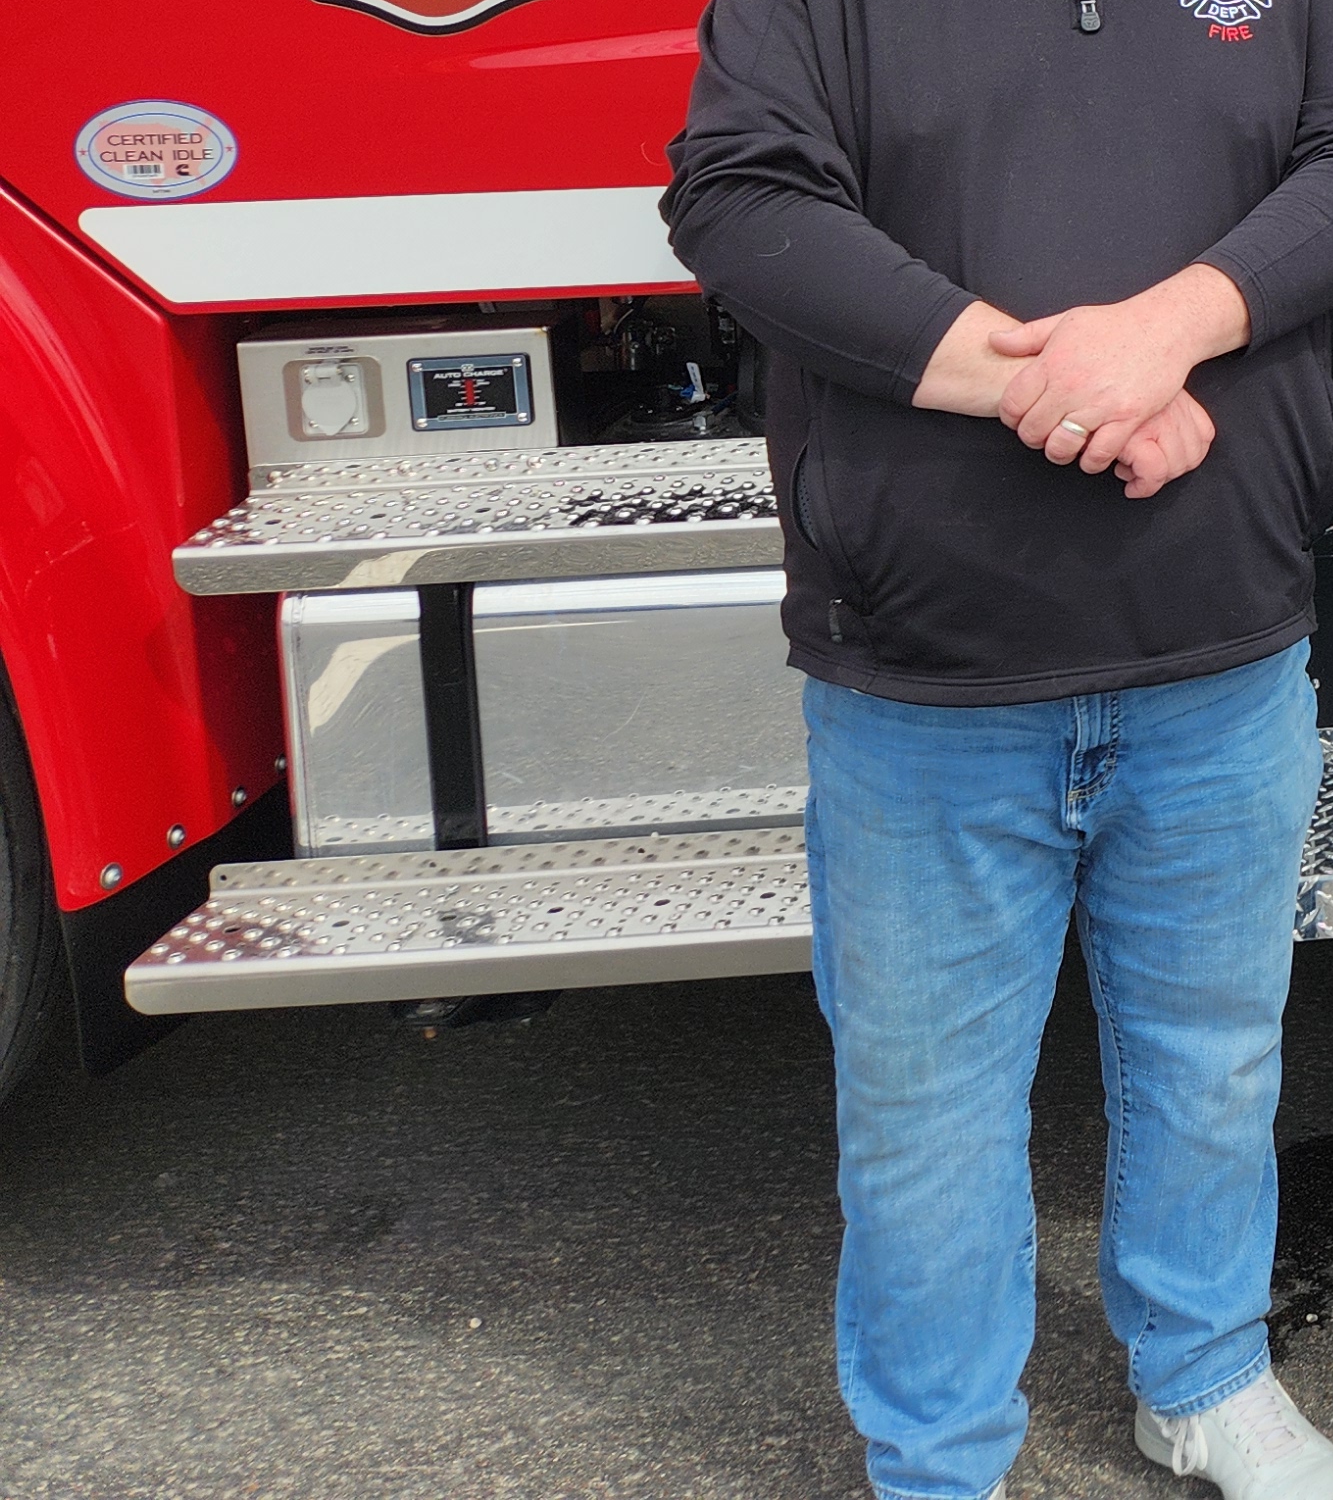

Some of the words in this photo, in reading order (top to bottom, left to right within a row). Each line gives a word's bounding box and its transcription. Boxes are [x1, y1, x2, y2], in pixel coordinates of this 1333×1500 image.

[1207, 3, 1248, 19] DEPT
[1208, 23, 1254, 42] FIRE
[107, 132, 203, 147] CERTIFIED
[100, 150, 164, 163] CLEAN
[172, 148, 215, 161] IDLE
[433, 371, 462, 380] AUTO
